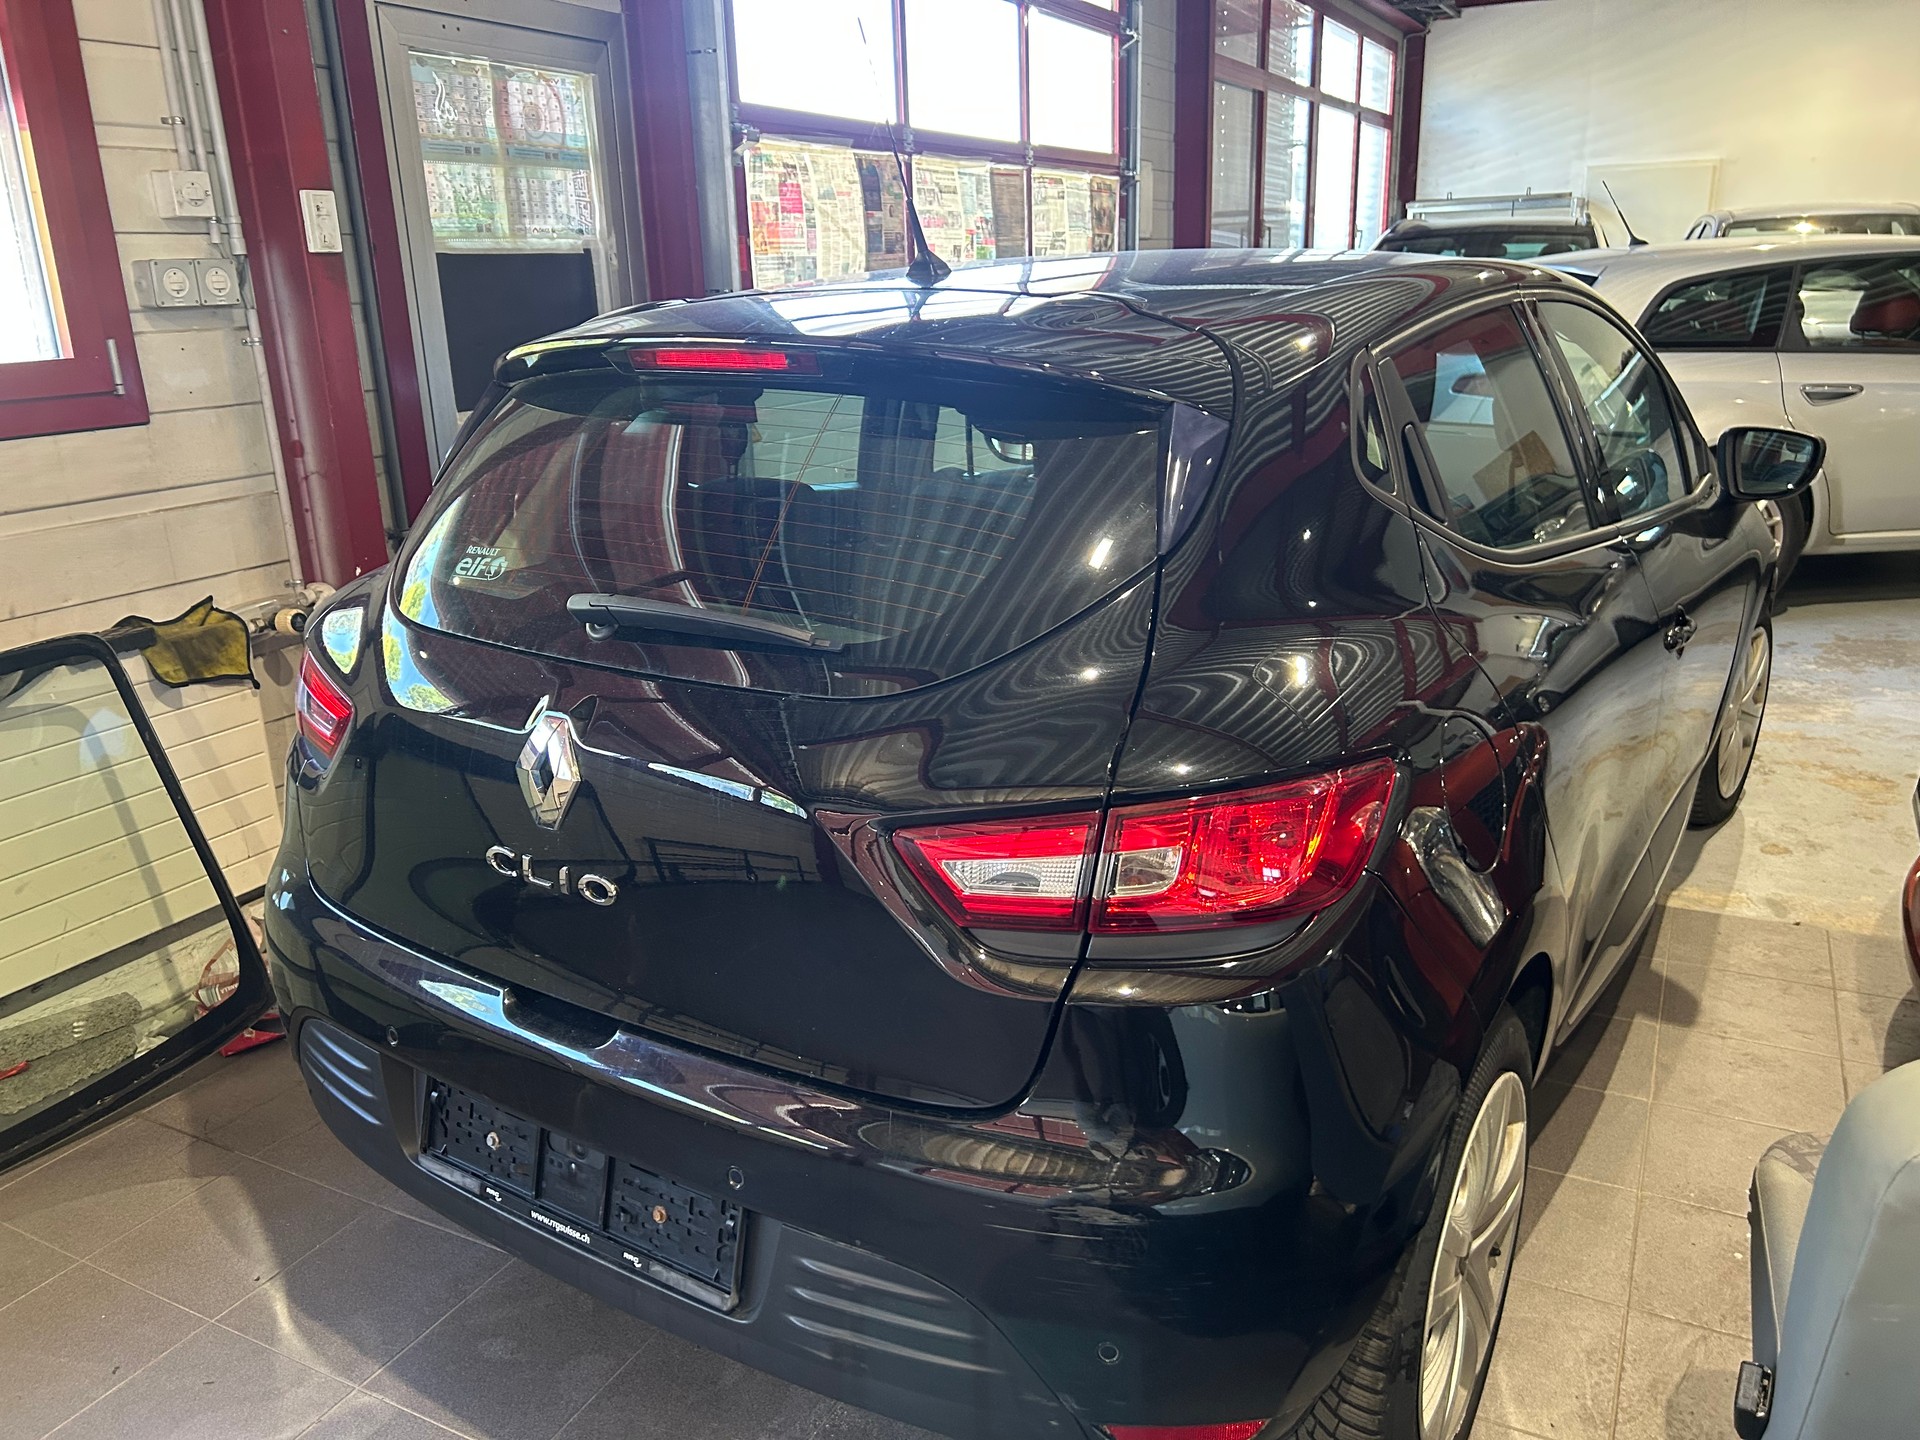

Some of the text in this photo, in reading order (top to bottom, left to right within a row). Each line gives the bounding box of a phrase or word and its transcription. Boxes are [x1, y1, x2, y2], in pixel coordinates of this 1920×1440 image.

[466, 545, 501, 556] RENAULT
[455, 556, 491, 576] elf
[485, 845, 620, 907] CLIO
[220, 982, 240, 994] ANILLA
[486, 1187, 501, 1199] RRG
[530, 1210, 590, 1244] www.rrgsuisse.ch
